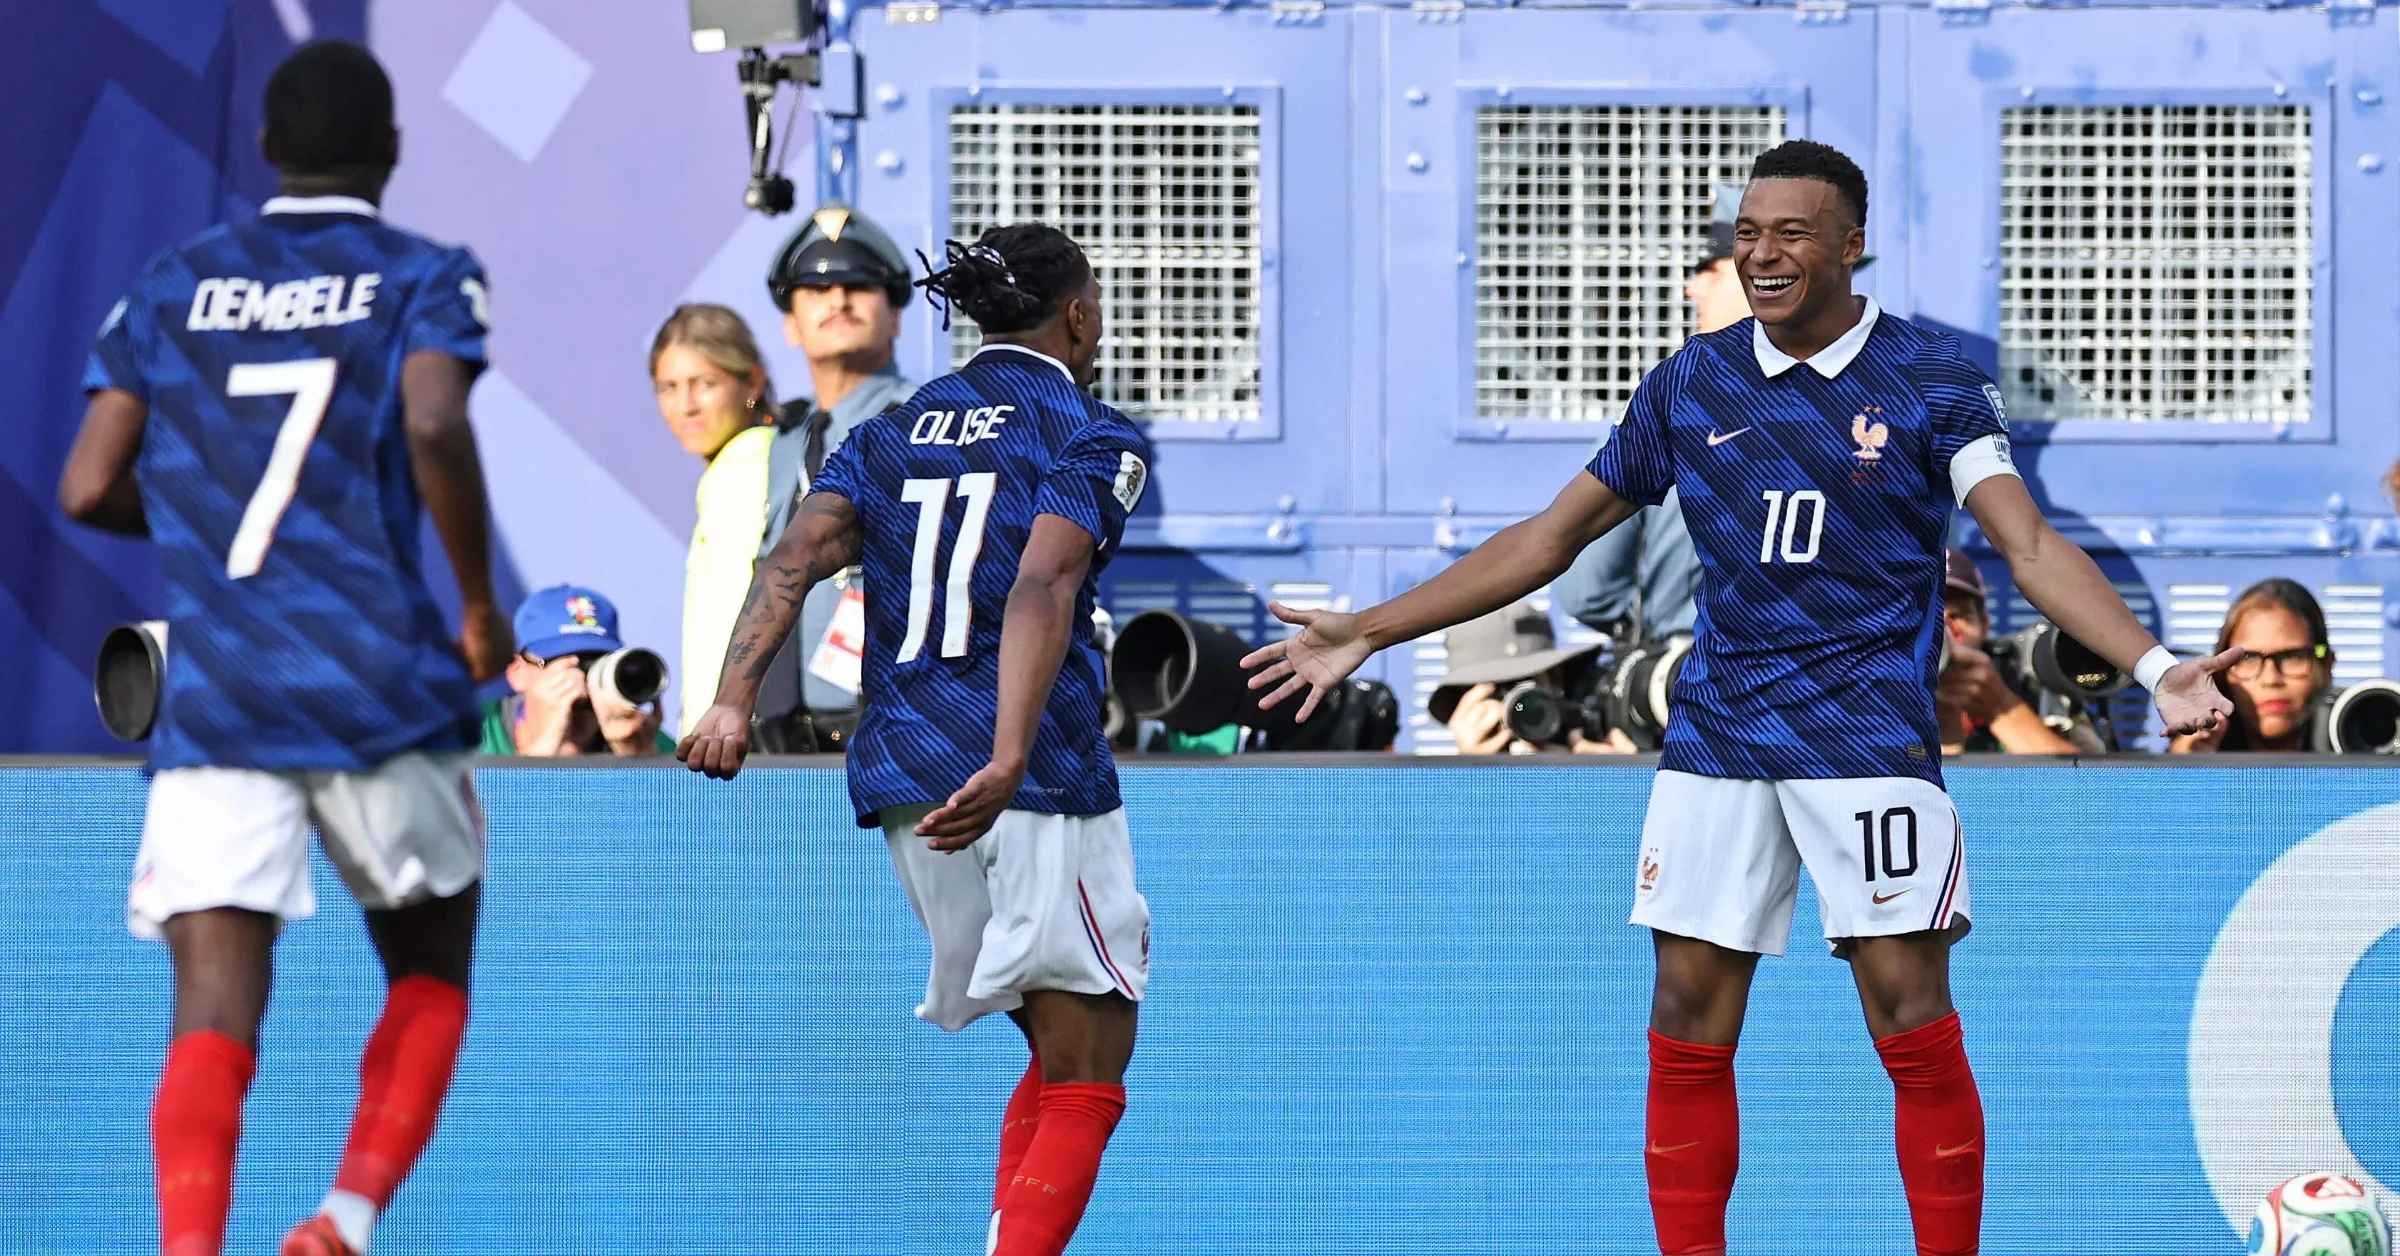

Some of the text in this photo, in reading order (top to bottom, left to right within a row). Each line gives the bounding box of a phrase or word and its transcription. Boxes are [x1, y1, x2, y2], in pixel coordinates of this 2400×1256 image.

[186, 272, 383, 331] DEMBELE
[909, 405, 1016, 447] OLISE
[226, 356, 339, 581] 7
[1760, 489, 1827, 563] 10
[895, 472, 998, 664] 11
[1854, 805, 1919, 882] 10
[1011, 1175, 1059, 1194] FFF
